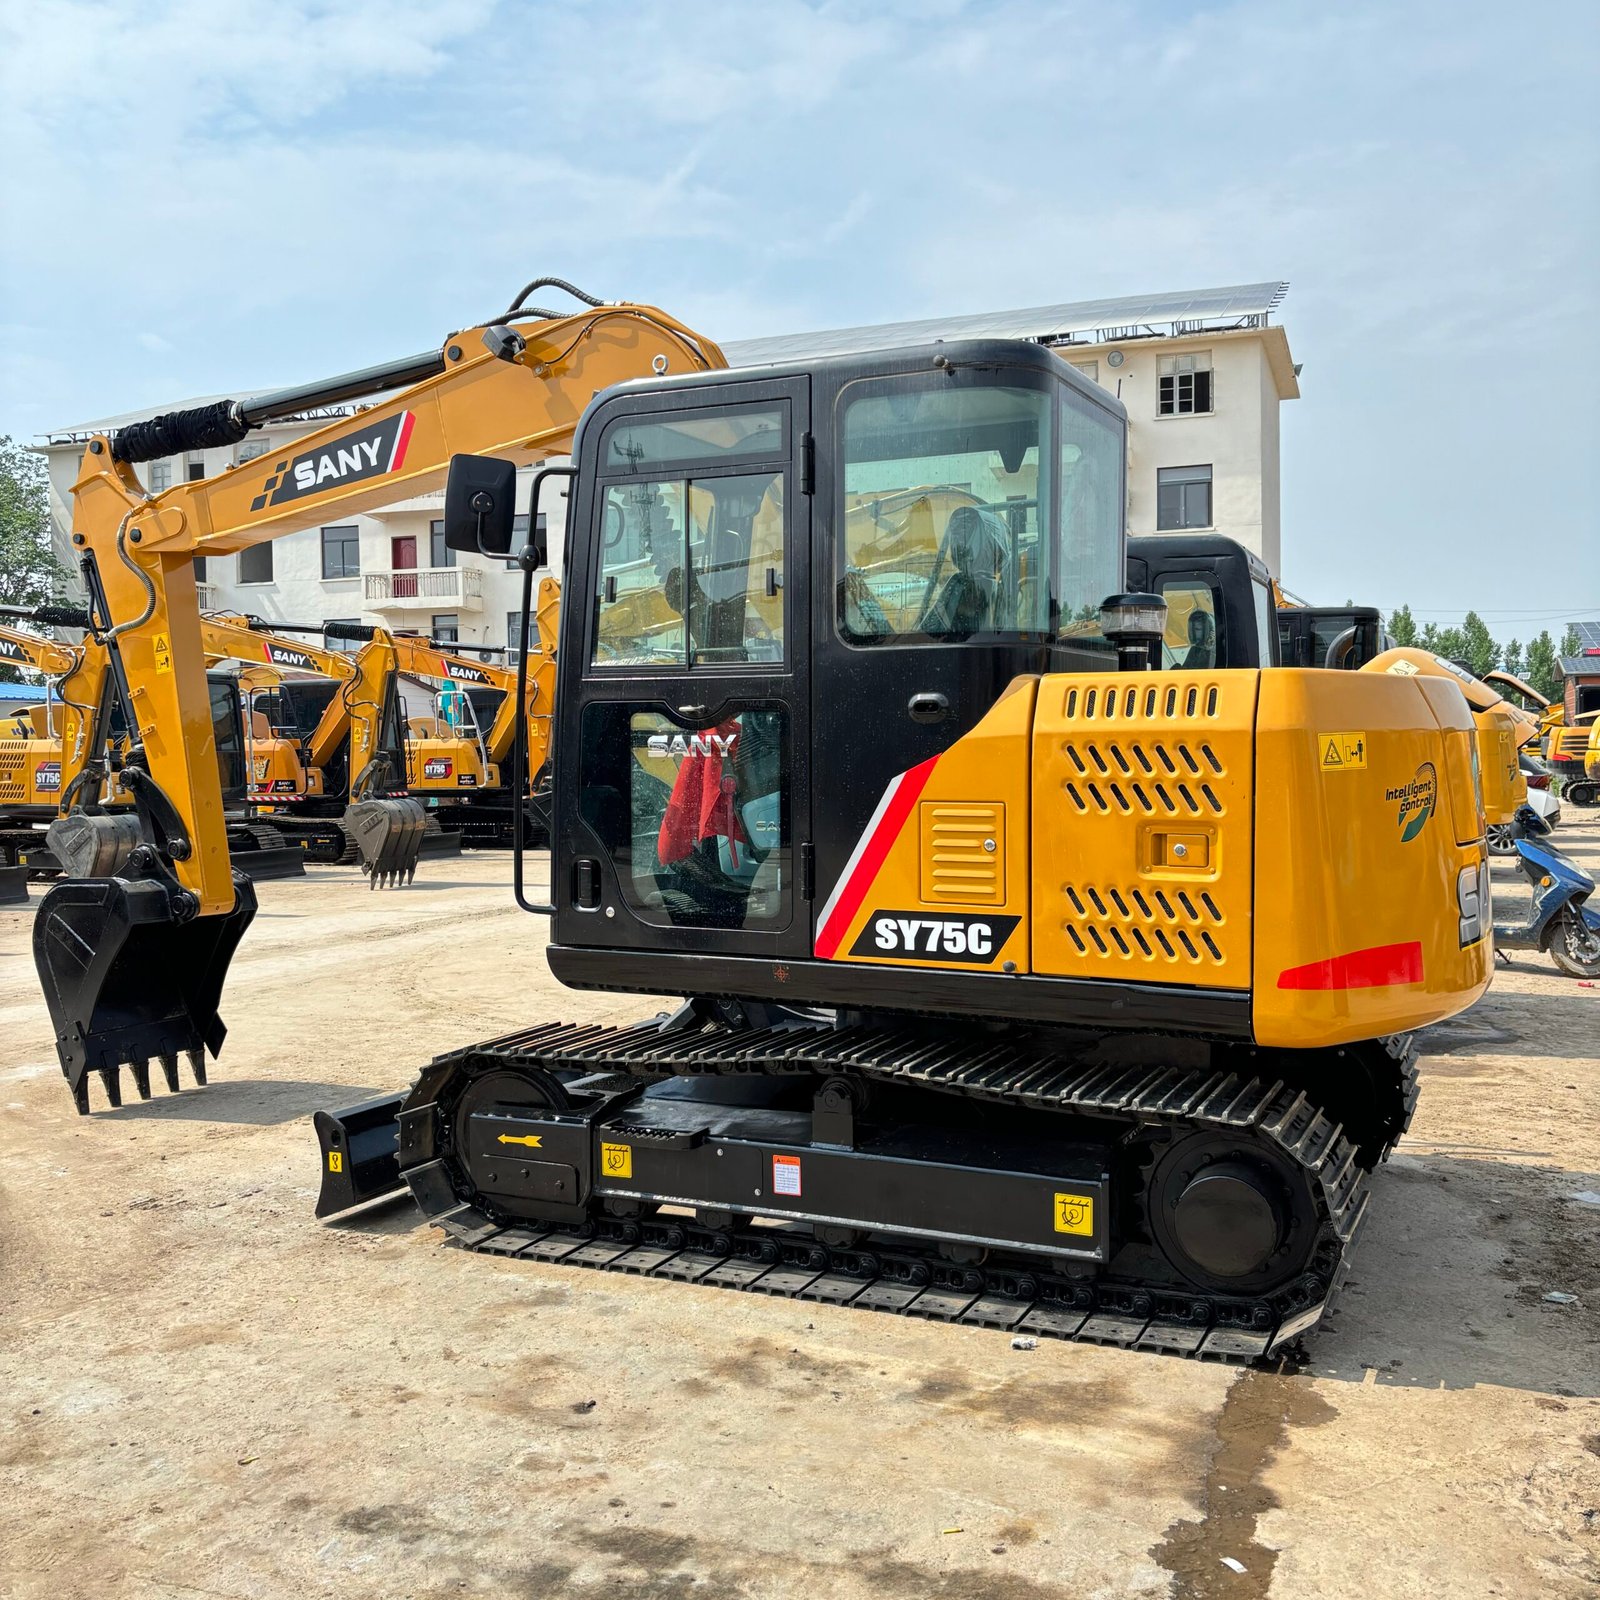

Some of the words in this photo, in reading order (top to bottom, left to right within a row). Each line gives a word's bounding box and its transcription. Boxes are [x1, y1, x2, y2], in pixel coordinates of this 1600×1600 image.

[294, 435, 382, 490] SANY
[273, 650, 306, 665] SANY
[450, 666, 481, 680] SANY
[646, 734, 737, 758] SANY
[36, 771, 61, 784] SY75C
[425, 765, 445, 774] SY75C
[1385, 778, 1432, 801] Intelligent
[1400, 796, 1431, 813] control
[875, 917, 993, 955] SY75C
